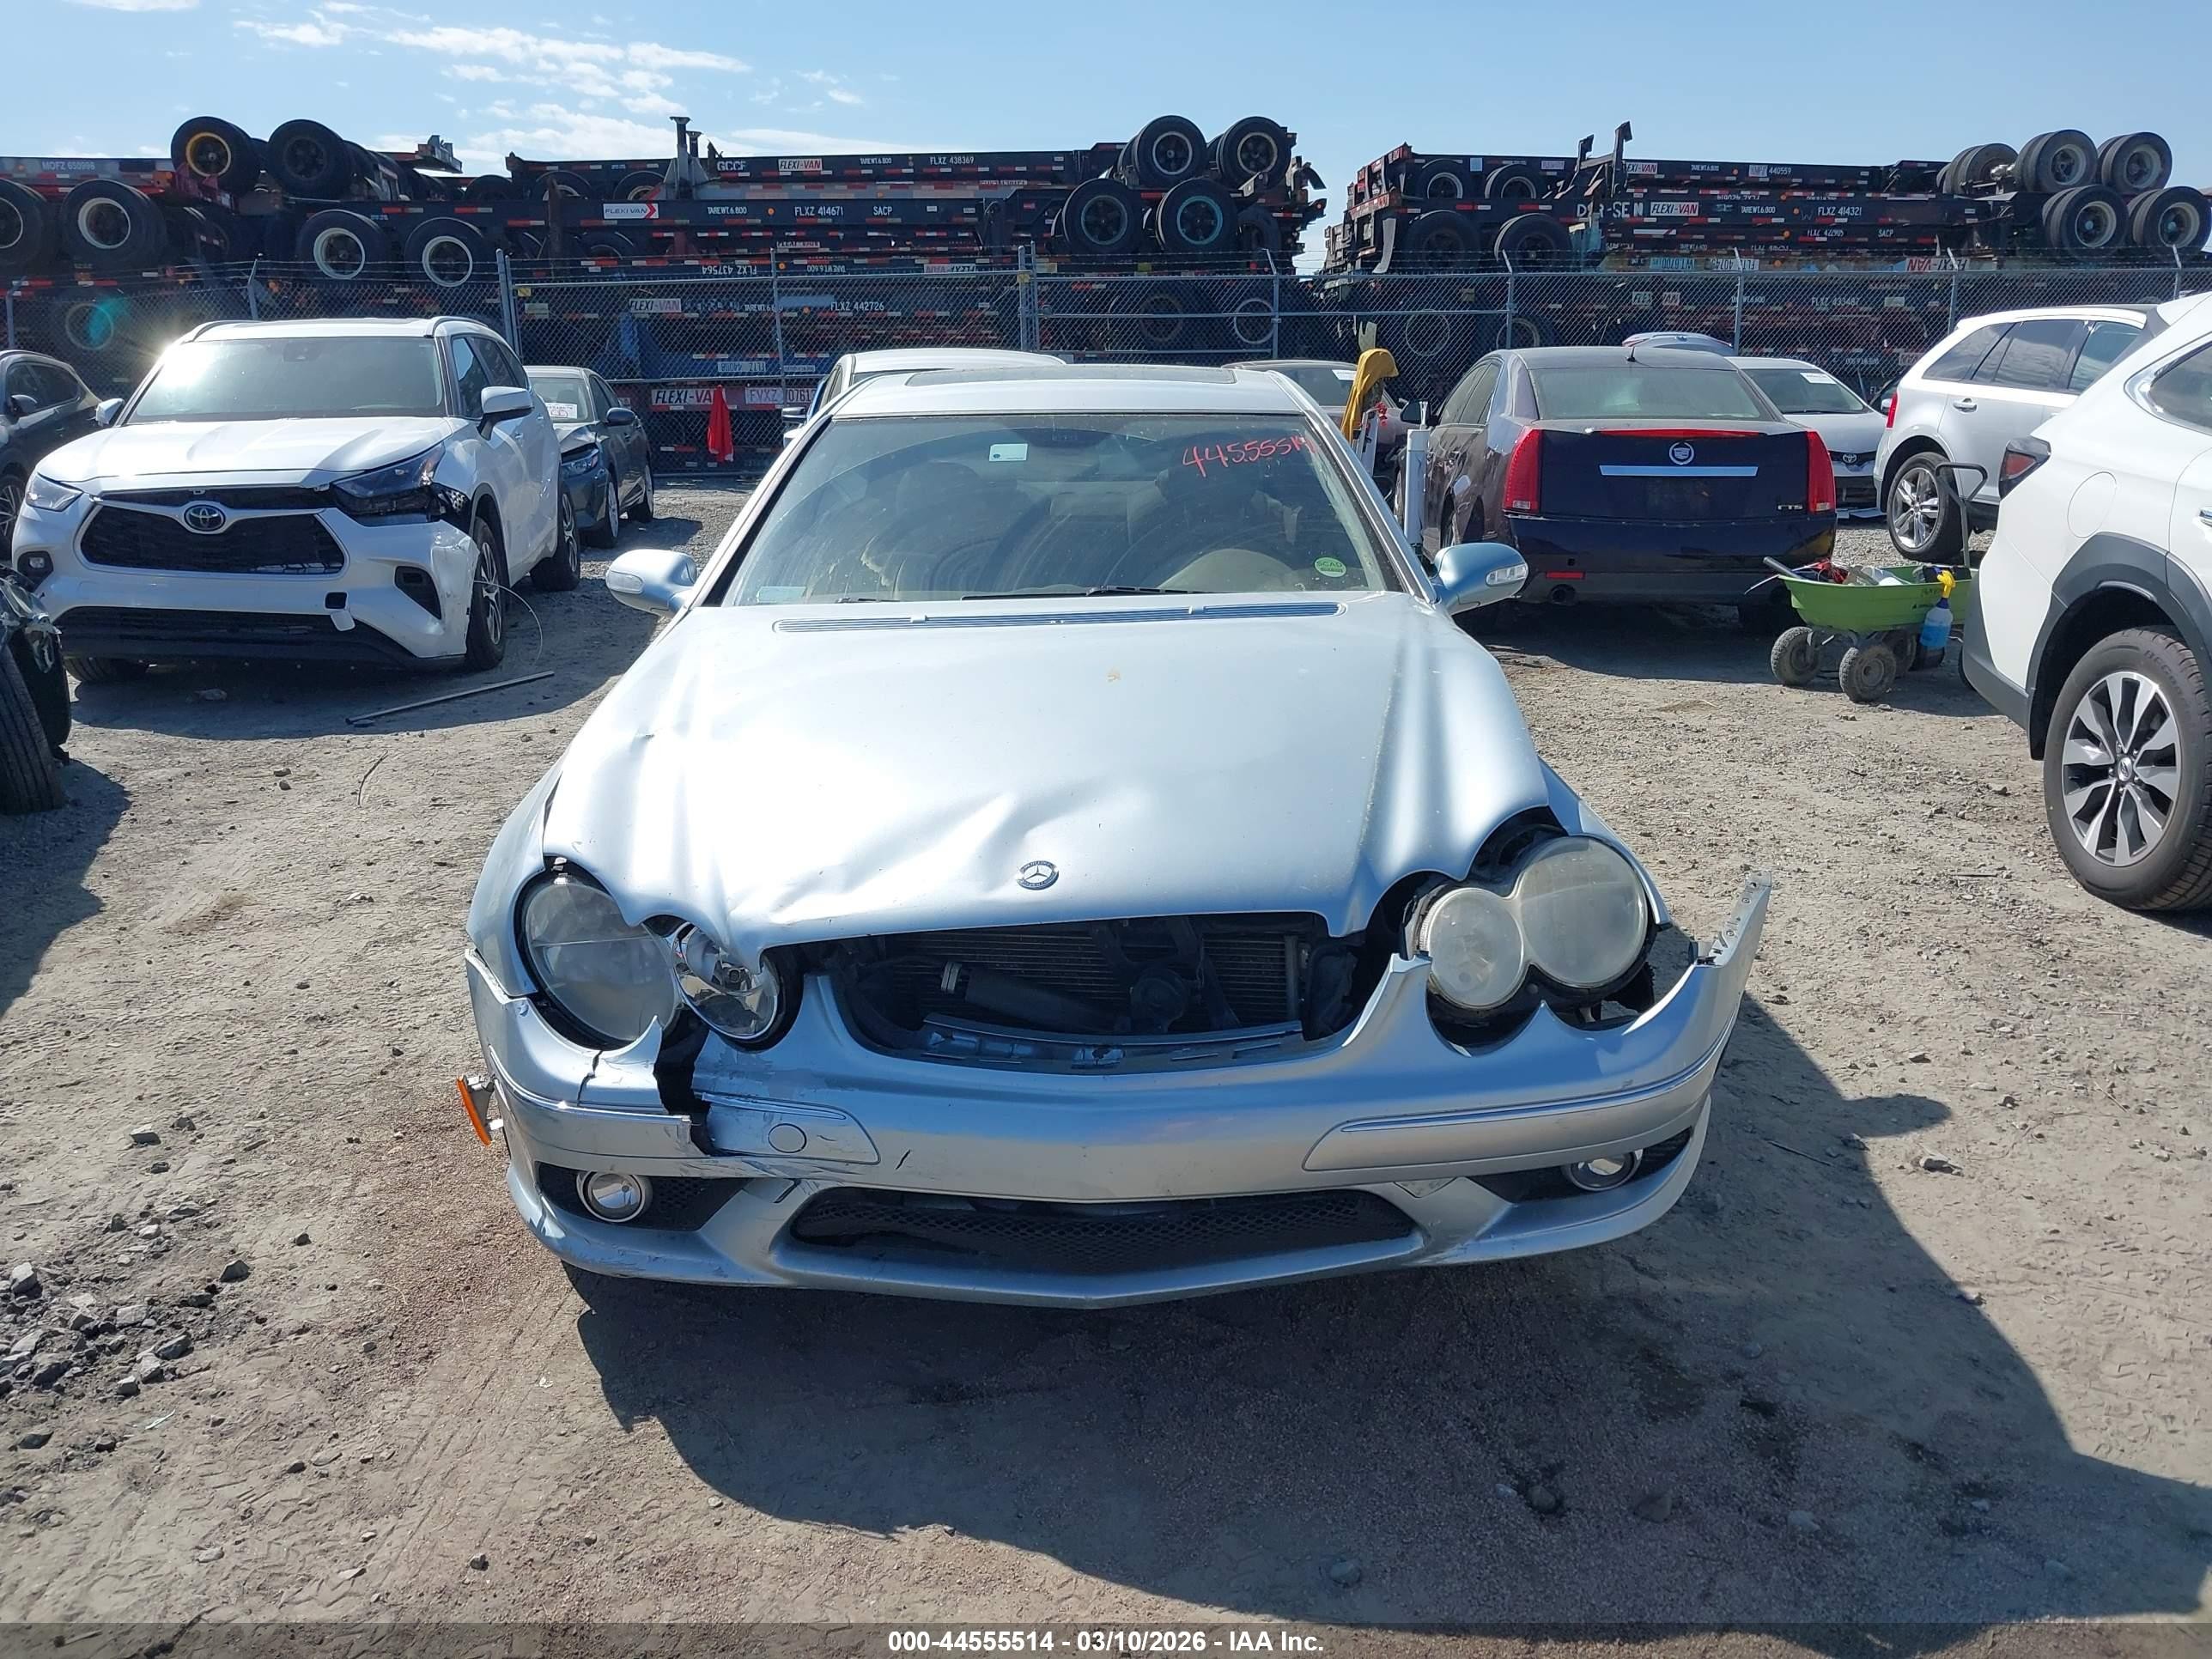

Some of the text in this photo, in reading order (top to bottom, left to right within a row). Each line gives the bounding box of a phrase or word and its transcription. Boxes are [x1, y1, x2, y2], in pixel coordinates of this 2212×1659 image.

[779, 159, 821, 169] FLEXI-VAN
[930, 155, 975, 165] FLXZ 438369
[794, 206, 843, 216] FLXZ 414671
[873, 206, 893, 215] SACP
[1651, 203, 1698, 215] FLEXI-VAN
[1818, 206, 1862, 216] FLXZ 414321
[702, 265, 757, 275] FLXZ 437564
[630, 300, 679, 311] FLEXI-VAN
[830, 301, 884, 311] FLXZ 442726
[655, 390, 713, 404] FLEXI-VA
[750, 390, 779, 402] FVXZ
